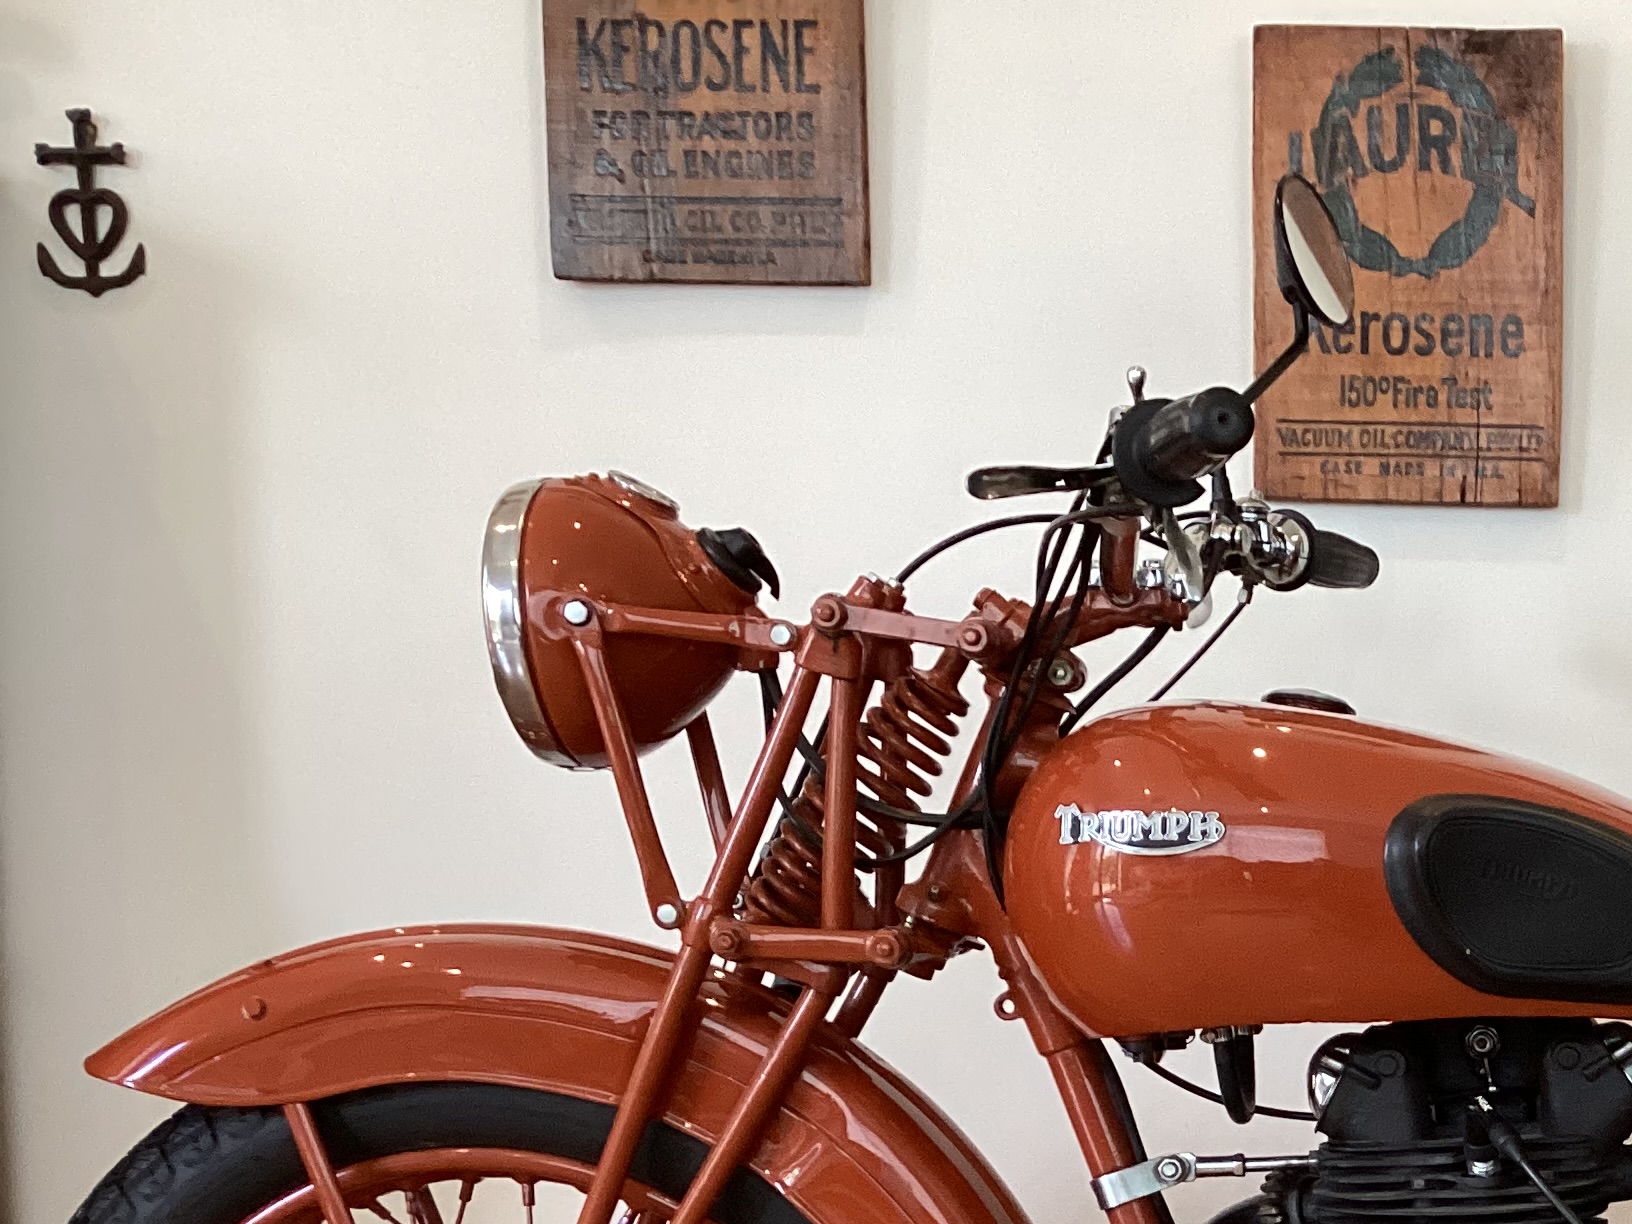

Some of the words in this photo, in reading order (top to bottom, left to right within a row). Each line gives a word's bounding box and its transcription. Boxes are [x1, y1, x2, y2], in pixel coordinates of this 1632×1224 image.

[576, 16, 821, 95] KEROSENE
[656, 110, 817, 142] TRACTORS
[683, 149, 817, 181] ENGINES
[1441, 376, 1494, 411] Test
[1276, 426, 1353, 450] VACUUM
[1359, 427, 1389, 451] OIL
[1319, 459, 1364, 476] CASE
[1055, 803, 1225, 846] TRIUMPH
